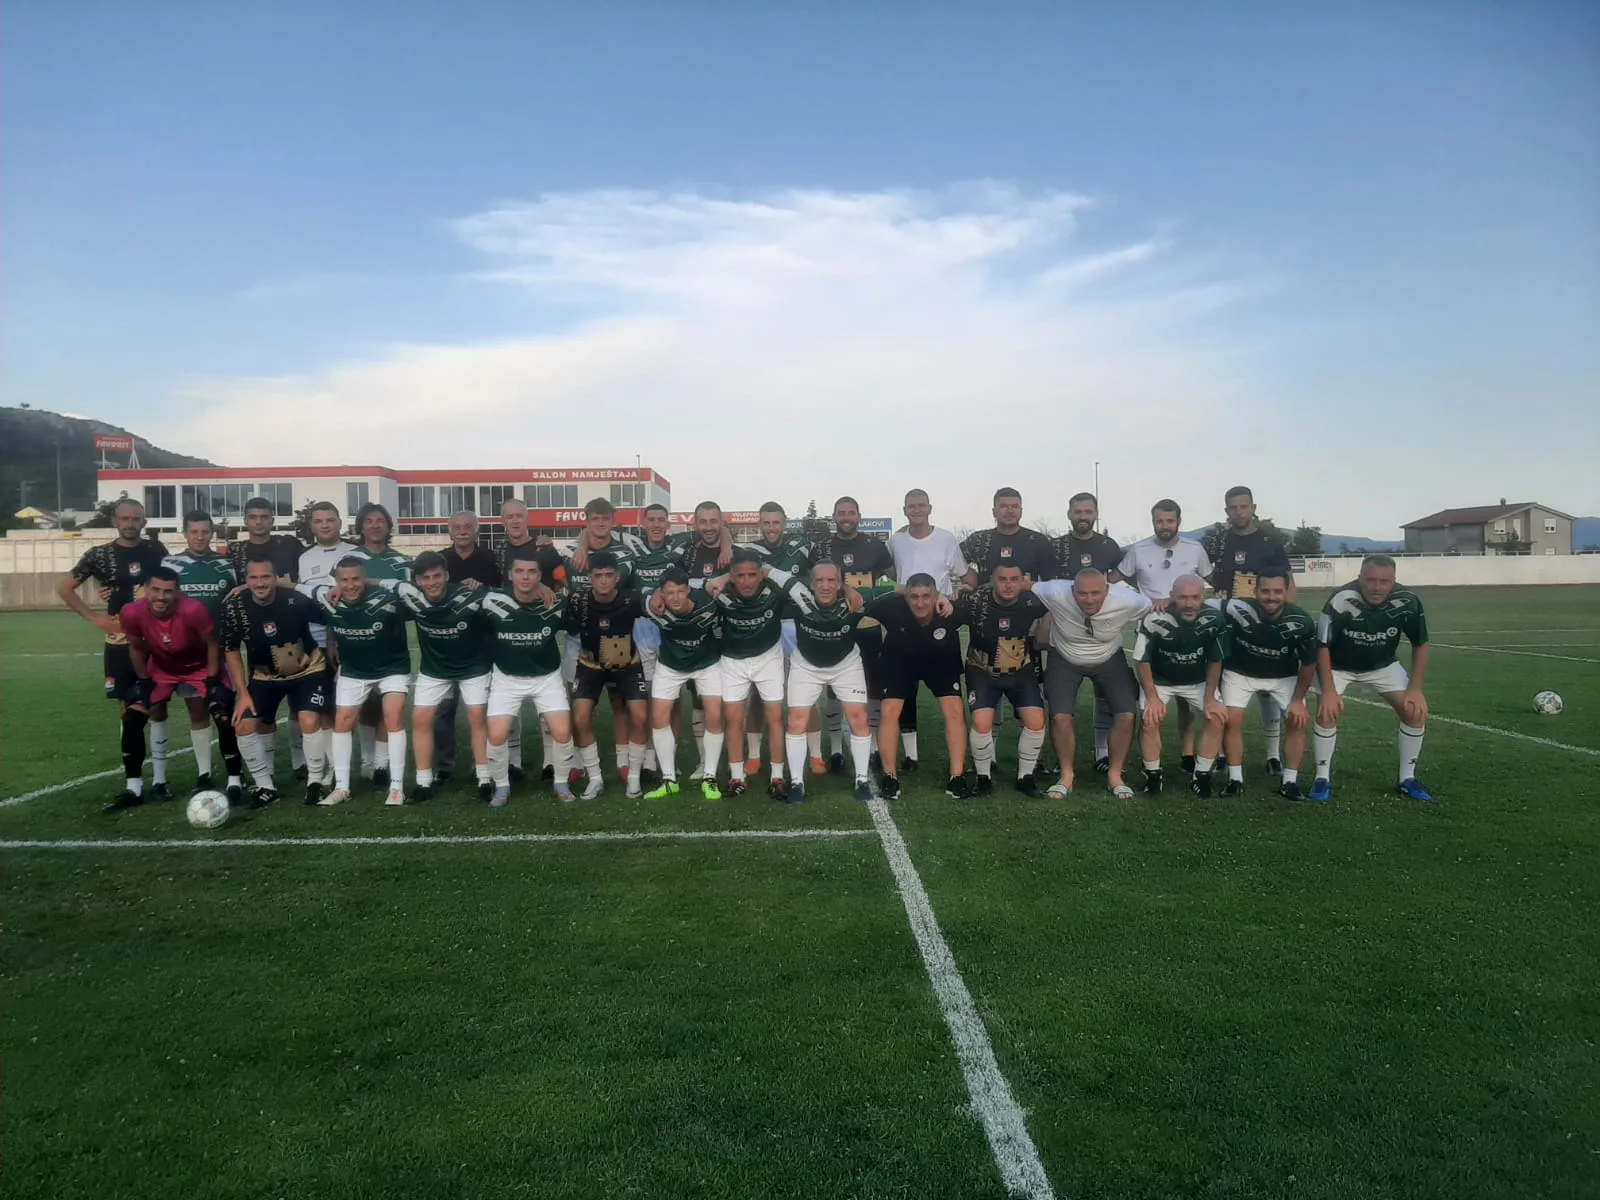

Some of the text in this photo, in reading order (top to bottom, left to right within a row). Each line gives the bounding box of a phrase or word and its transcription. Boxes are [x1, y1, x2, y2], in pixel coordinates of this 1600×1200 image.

[532, 470, 638, 479] SALON NAMJEŠTAJA
[555, 511, 587, 522] FAVO
[497, 631, 543, 641] MESSER
[310, 692, 325, 707] 20
